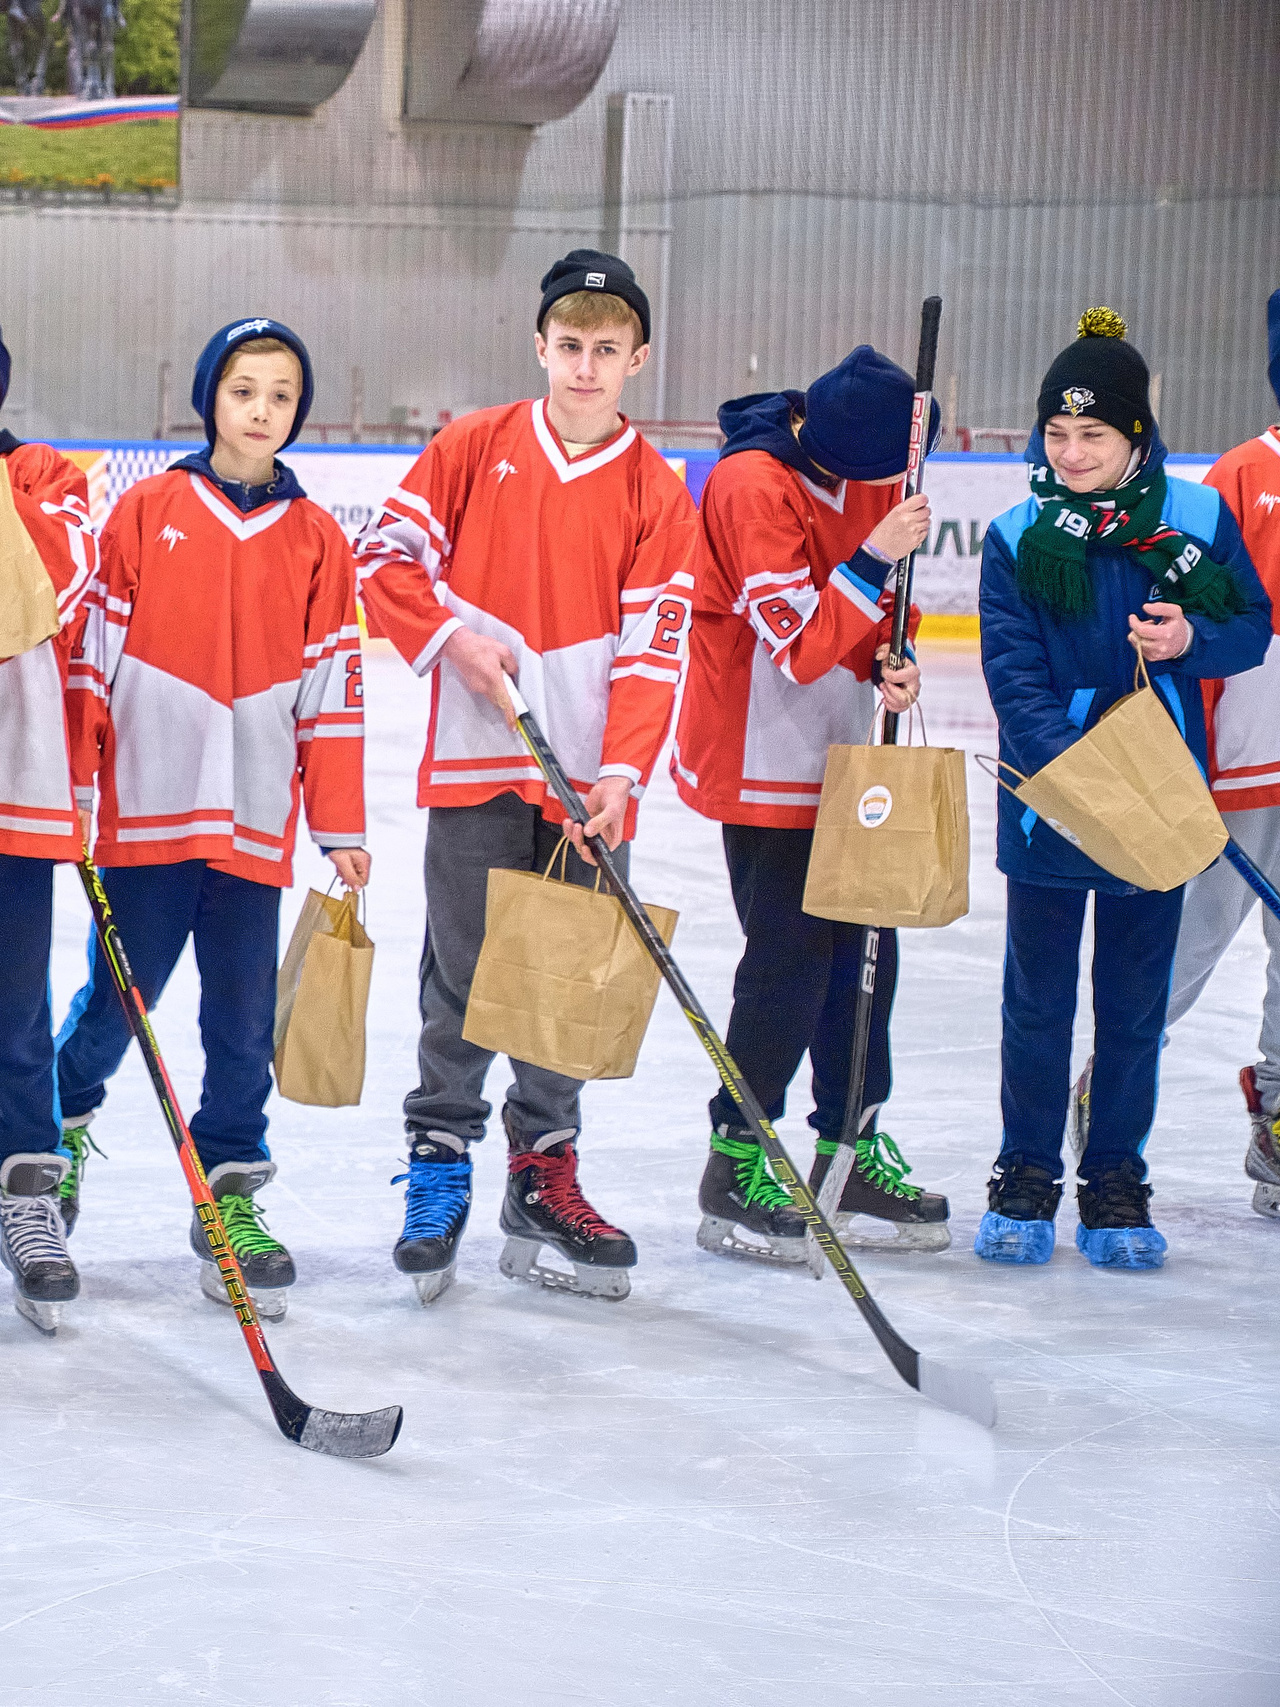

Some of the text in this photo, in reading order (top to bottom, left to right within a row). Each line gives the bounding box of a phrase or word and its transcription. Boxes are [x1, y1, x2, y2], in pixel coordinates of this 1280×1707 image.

[649, 599, 687, 654] 2
[195, 1202, 256, 1328] BAUER
[770, 1158, 866, 1299] BAUER
